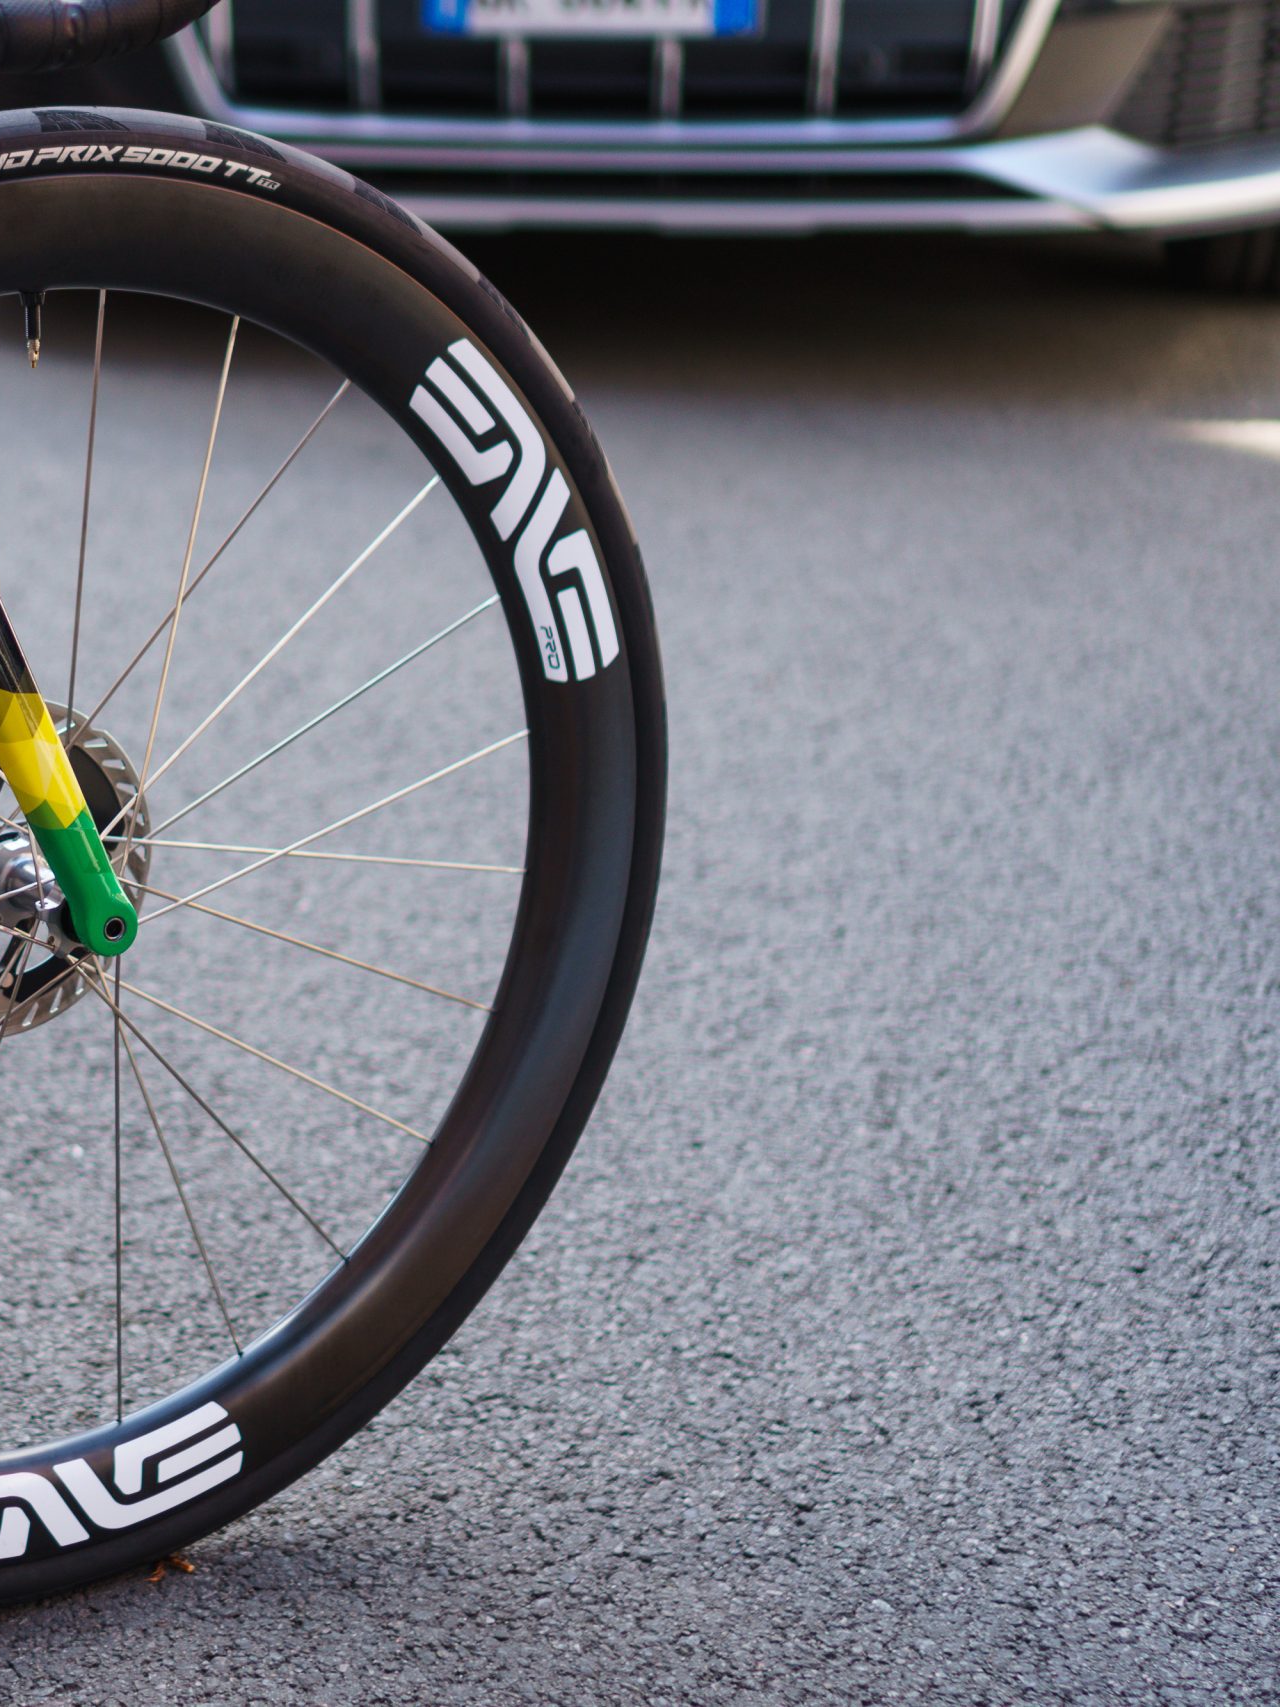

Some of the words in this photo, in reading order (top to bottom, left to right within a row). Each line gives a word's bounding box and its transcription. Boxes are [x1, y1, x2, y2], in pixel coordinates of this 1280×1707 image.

[31, 145, 124, 166] PRIX
[119, 146, 223, 174] 5000
[224, 160, 272, 184] TT
[409, 338, 620, 683] ENVE
[540, 625, 561, 670] PRO
